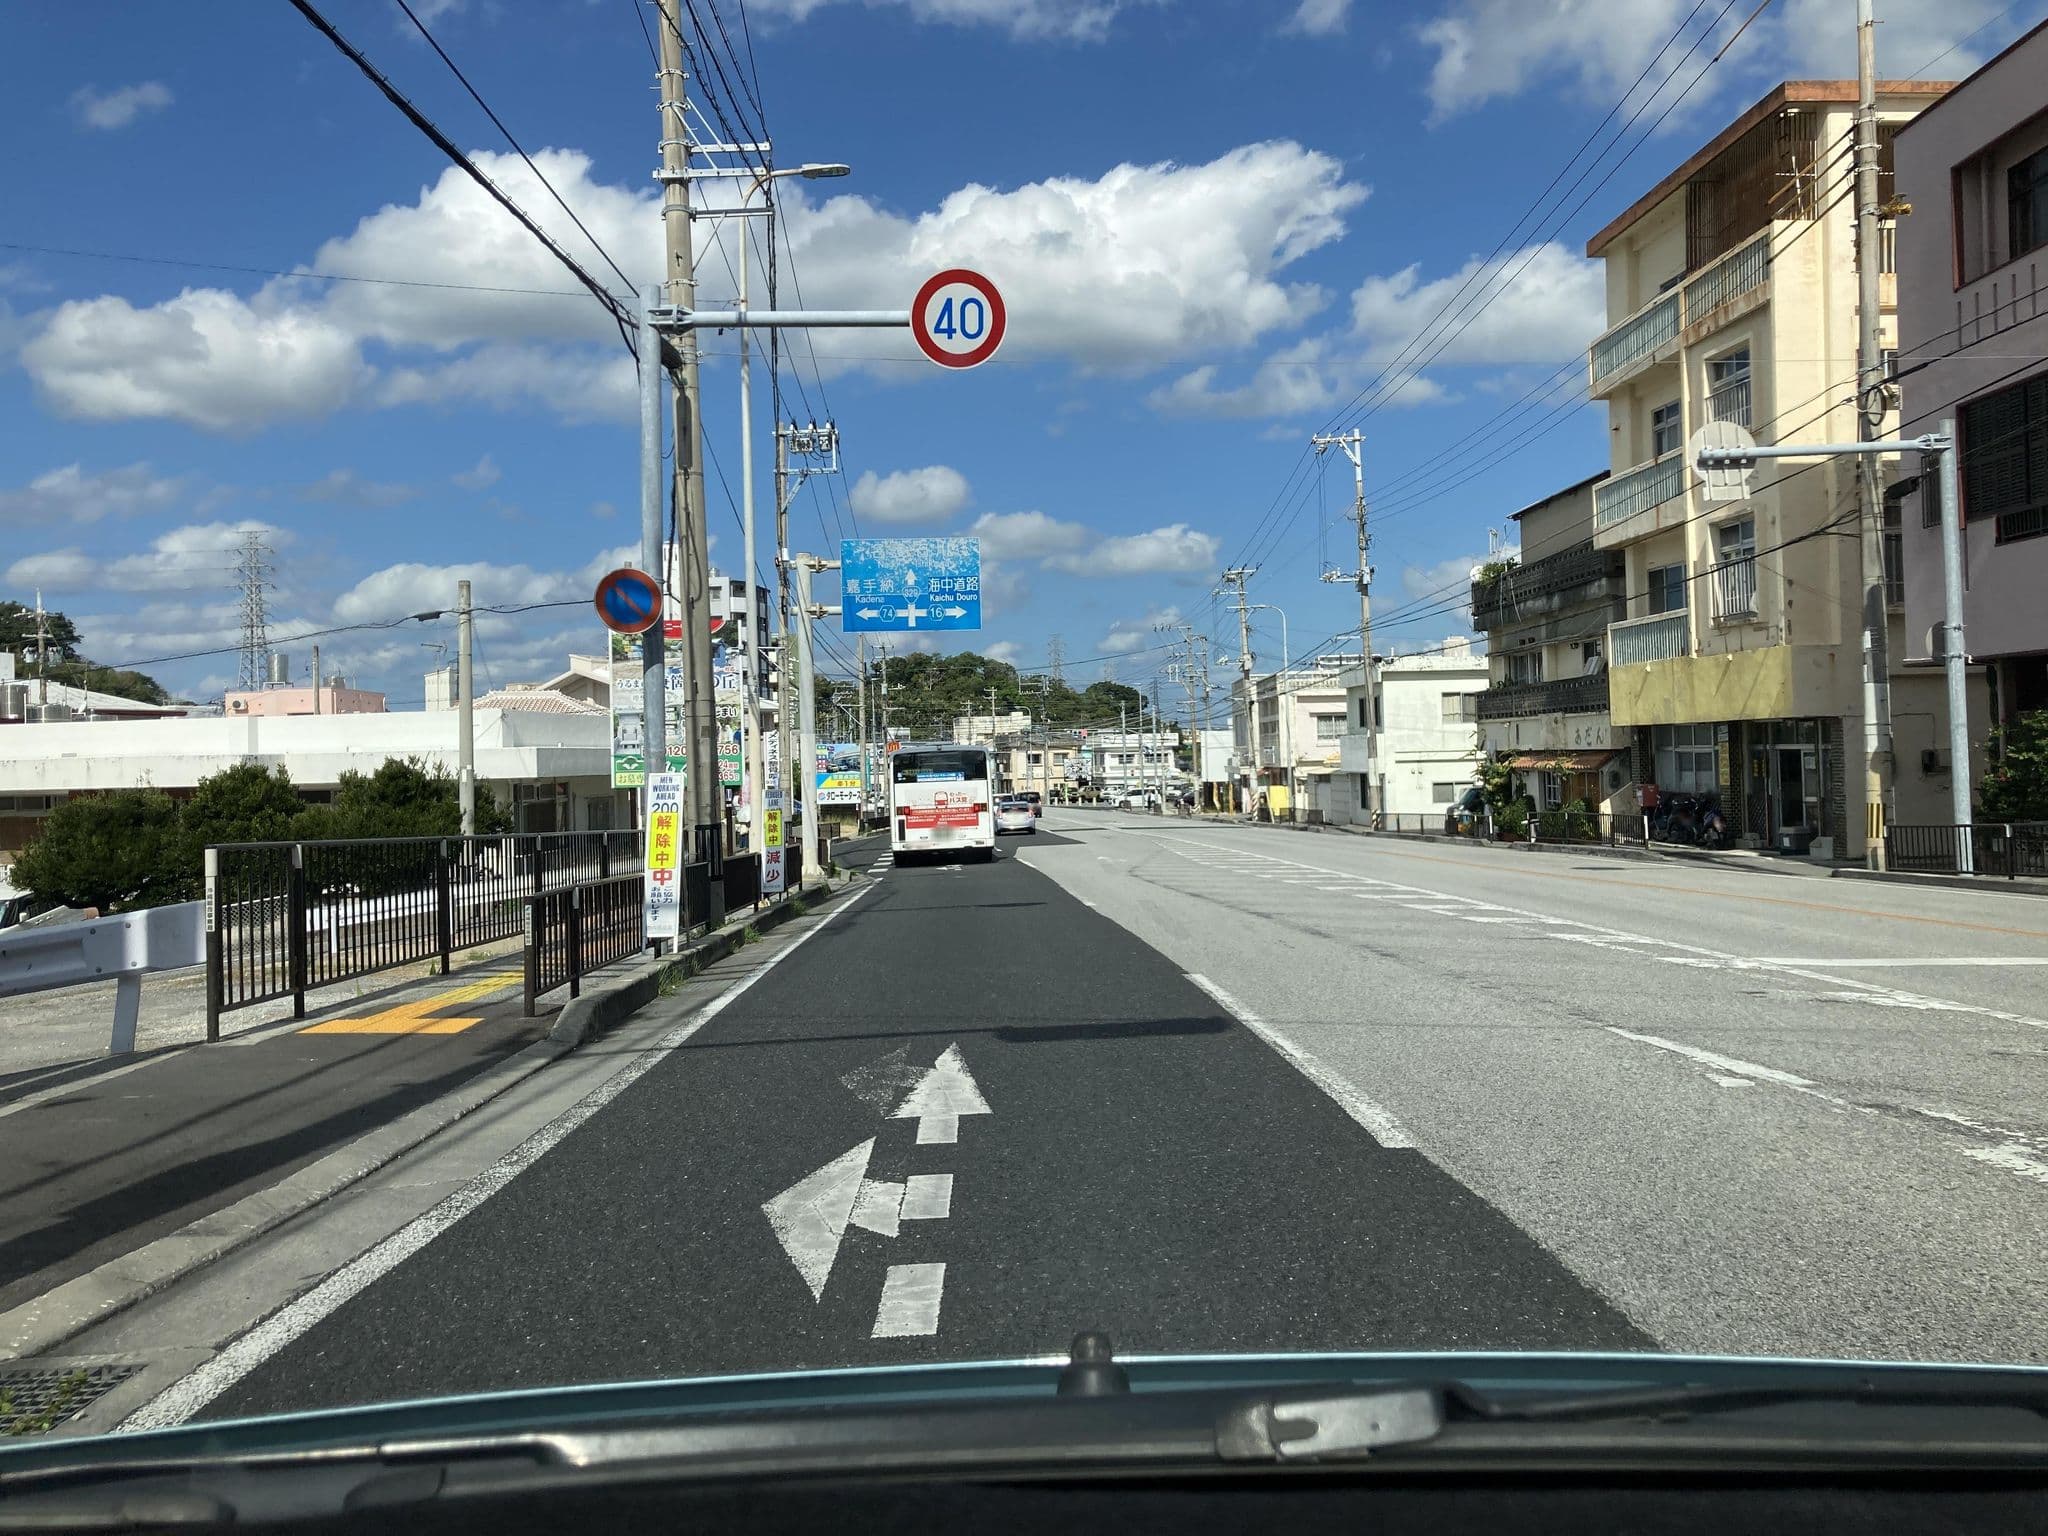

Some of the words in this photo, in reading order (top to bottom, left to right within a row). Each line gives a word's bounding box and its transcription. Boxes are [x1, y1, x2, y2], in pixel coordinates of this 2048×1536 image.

[934, 297, 984, 340] 40
[846, 579, 894, 594] 嘉手納
[928, 577, 979, 592] 海中道路
[855, 595, 885, 604] Kadena
[930, 593, 954, 602] Kaichu
[956, 593, 978, 601] Douro
[882, 608, 893, 619] 74
[930, 607, 943, 618] 16
[616, 679, 644, 689] うるま
[659, 776, 673, 784] MEN
[652, 784, 680, 792] WORKING
[656, 792, 676, 800] AHEAD
[767, 812, 779, 844] 解除中
[655, 814, 673, 866] 解除中
[766, 851, 781, 883] 減少
[653, 868, 673, 886] 中
